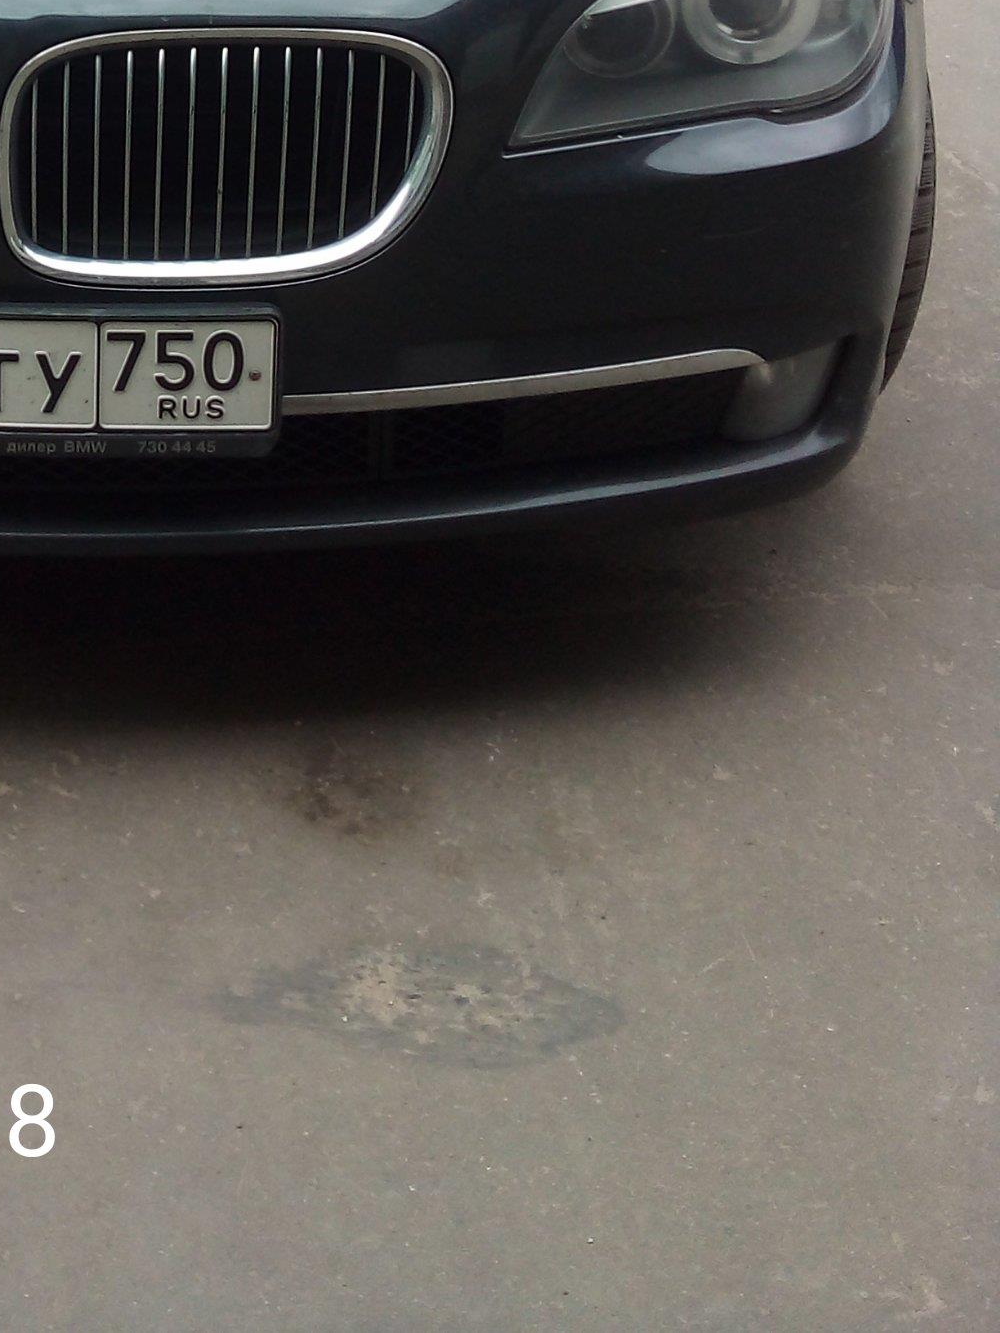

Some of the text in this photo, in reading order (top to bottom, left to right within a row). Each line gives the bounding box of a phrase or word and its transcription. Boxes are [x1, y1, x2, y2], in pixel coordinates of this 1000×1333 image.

[106, 328, 246, 393] 750
[156, 395, 225, 420] RUS
[6, 441, 57, 454] дилер
[64, 441, 108, 454] BMW
[138, 440, 168, 454] 730
[171, 441, 193, 454] 44
[195, 441, 217, 454] 45
